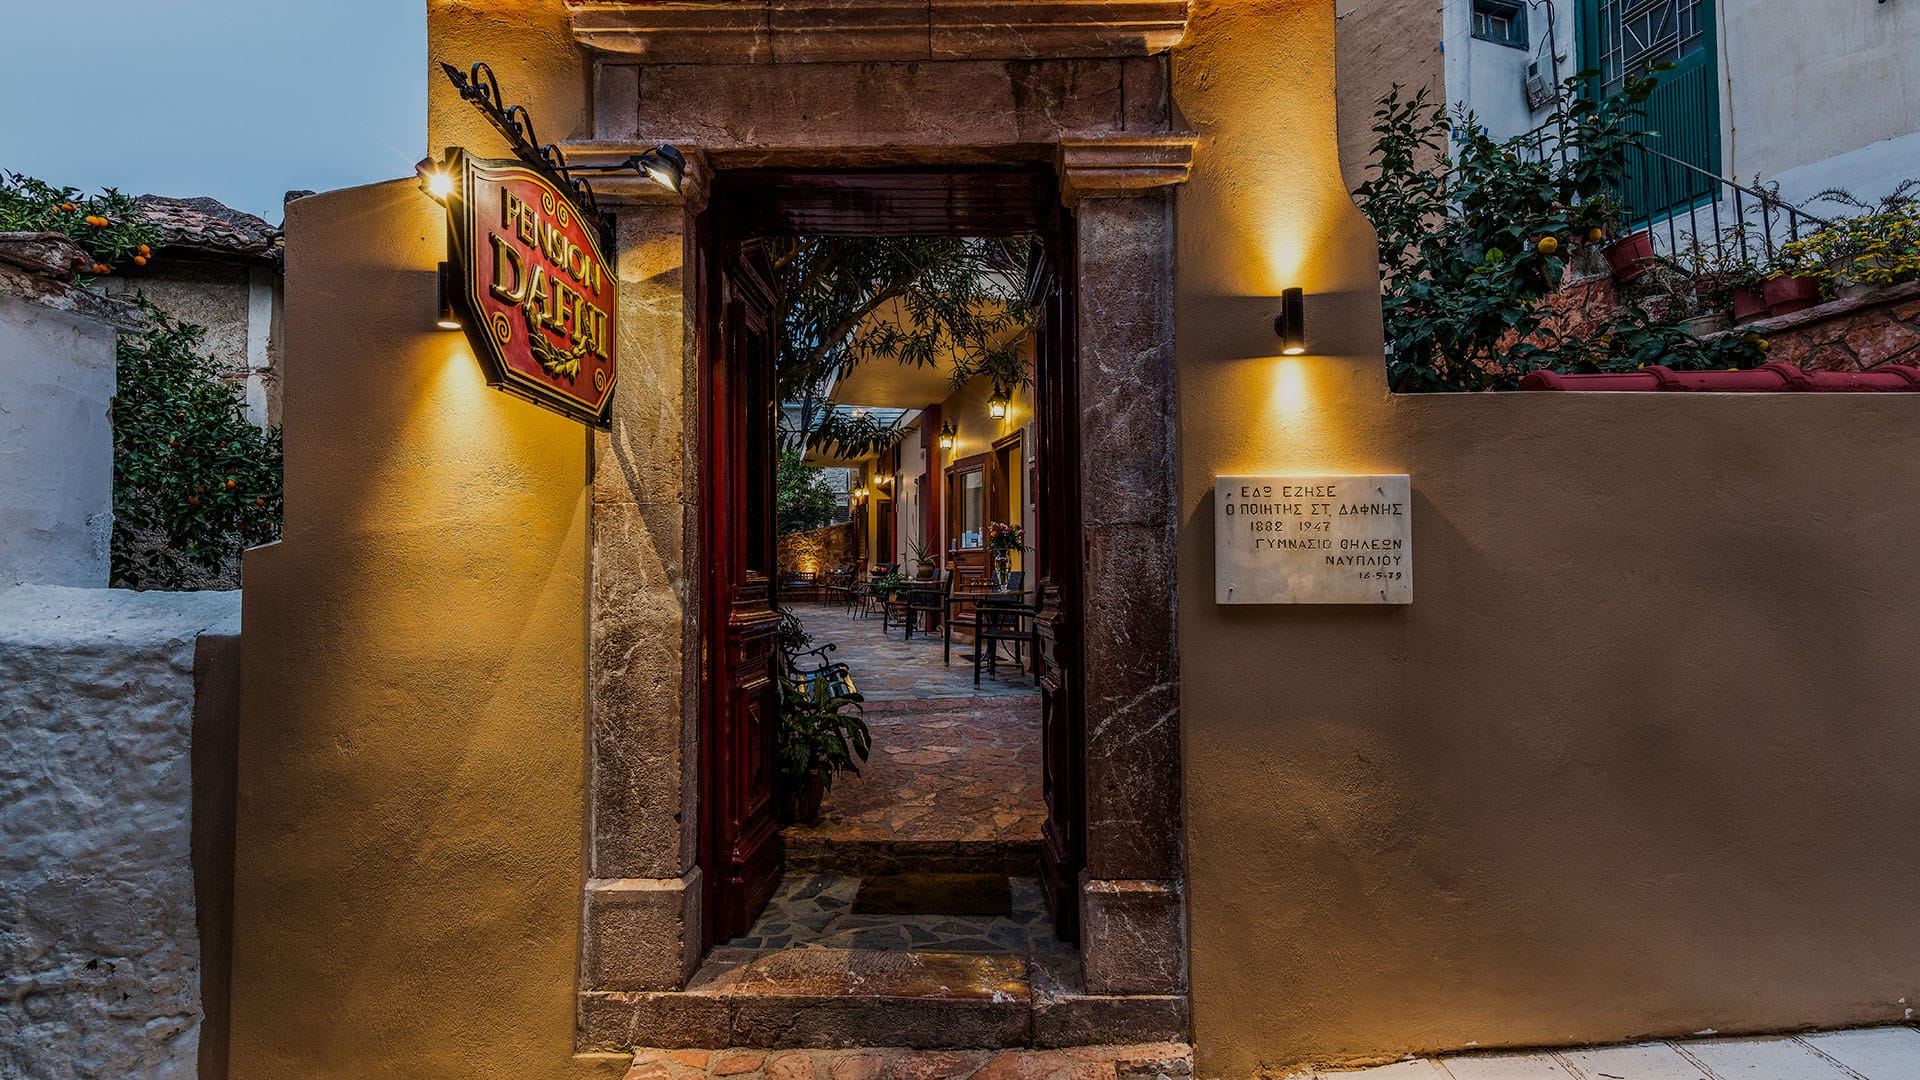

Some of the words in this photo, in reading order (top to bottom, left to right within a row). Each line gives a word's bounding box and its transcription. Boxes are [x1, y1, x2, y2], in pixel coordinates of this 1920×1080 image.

[501, 186, 601, 296] PENSION
[489, 231, 608, 361] DAFNI
[1241, 486, 1272, 498] ΕΔΩ
[1283, 486, 1337, 498] ΕΖΗΣΕ
[1240, 504, 1303, 516] ΠΟΙΗΤΗΣ
[1339, 503, 1403, 516] ΔΑΦΝΗΣ
[1250, 521, 1284, 532] 1882
[1299, 521, 1331, 532] 1947
[1256, 538, 1332, 550] ΓΥΜΝΑΣΙΟ
[1340, 538, 1403, 550] ΘΗΛΕΩΝ
[1325, 555, 1401, 566] ΝΑΥΠΛΙΟΥ
